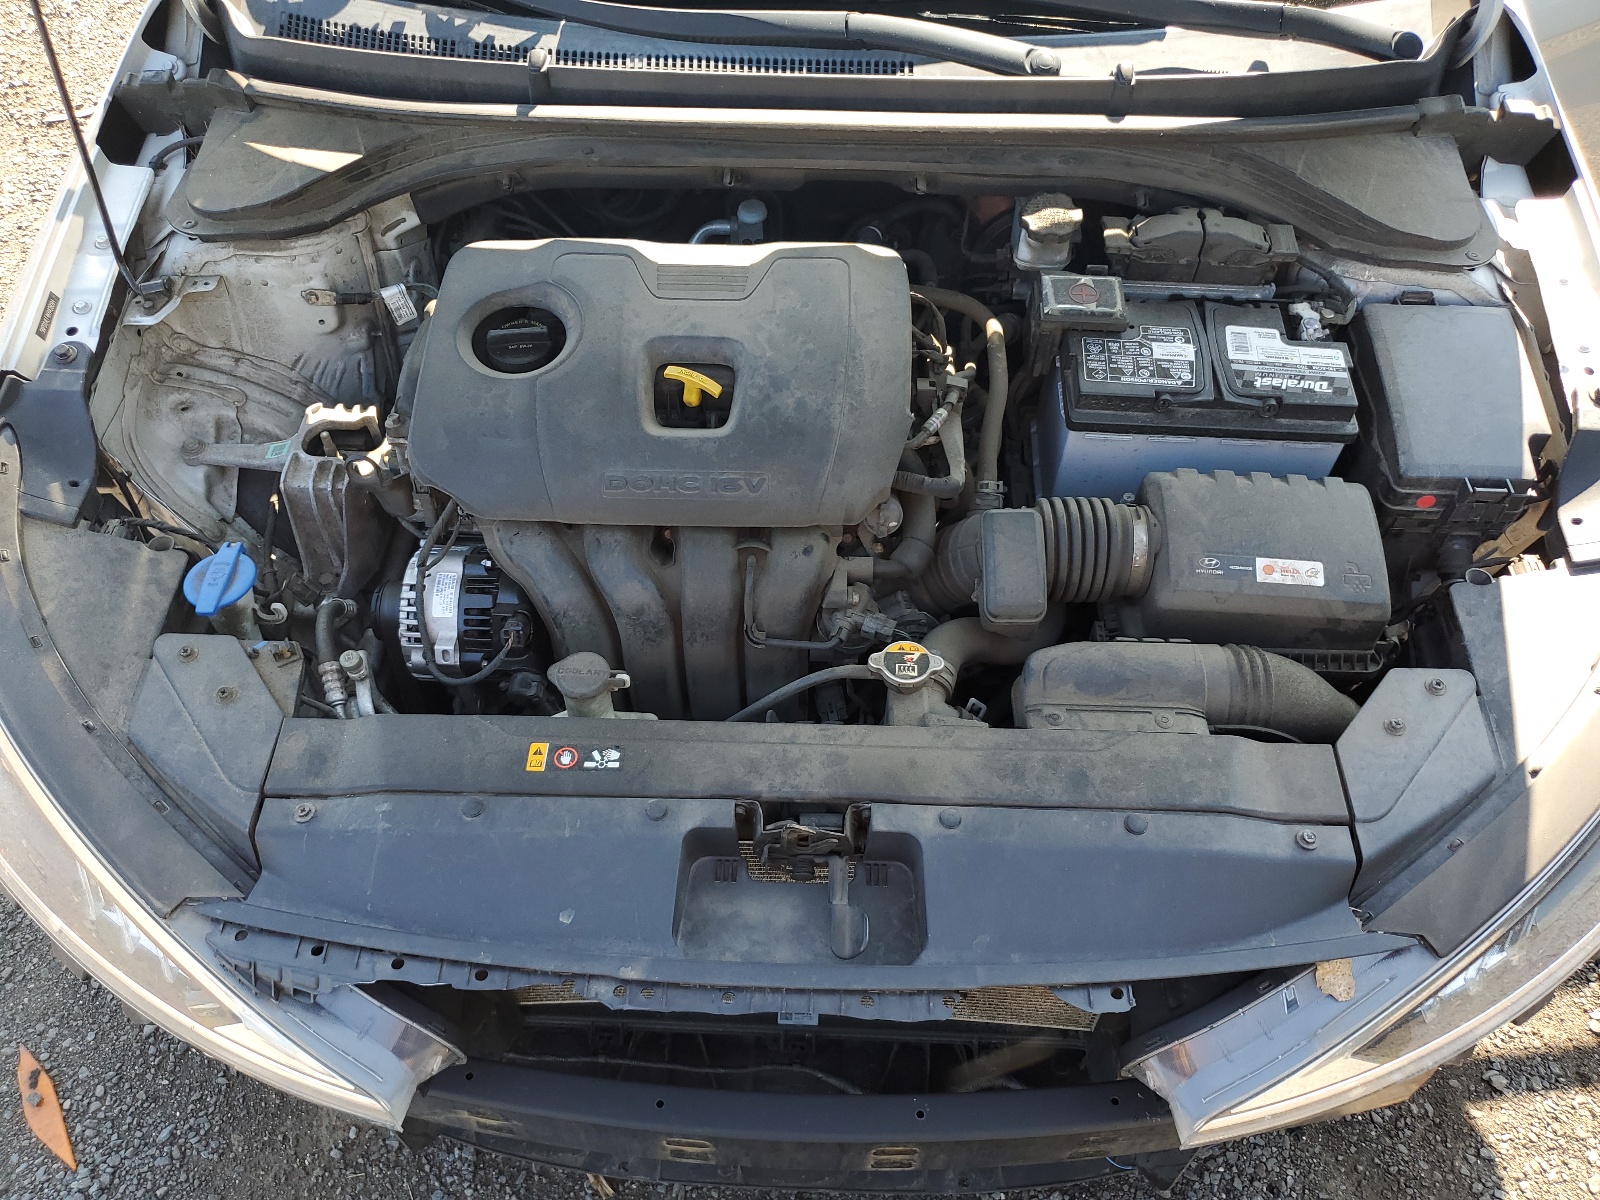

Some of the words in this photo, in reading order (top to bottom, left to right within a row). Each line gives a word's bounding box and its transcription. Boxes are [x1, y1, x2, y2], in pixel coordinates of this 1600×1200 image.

[1254, 372, 1302, 380] PLATINUM
[1253, 376, 1334, 393] Duralast
[604, 474, 701, 493] DOHC
[709, 476, 767, 494] 16V
[557, 667, 607, 676] COOLANT
